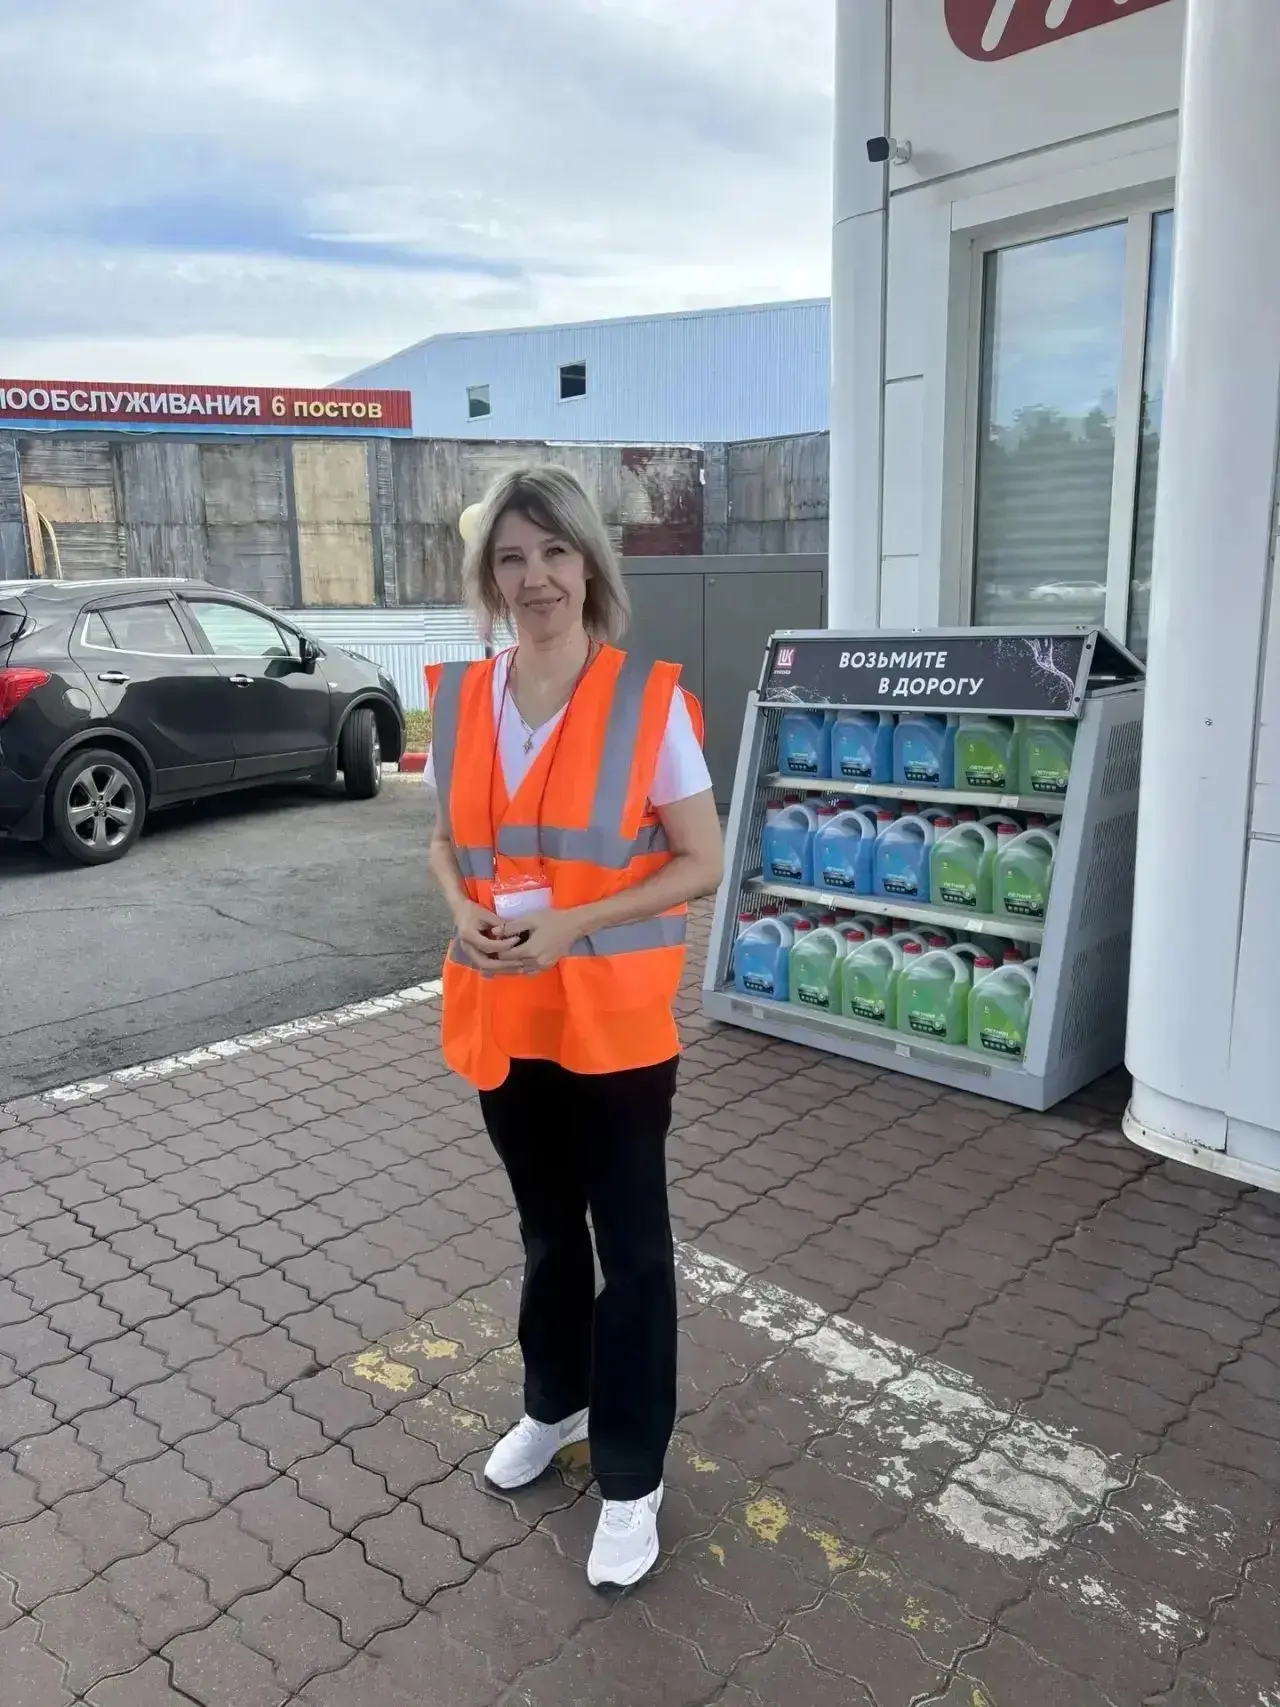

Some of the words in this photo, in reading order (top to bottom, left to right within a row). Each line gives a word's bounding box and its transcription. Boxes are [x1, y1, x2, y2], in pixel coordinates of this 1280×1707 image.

[271, 395, 287, 417] 6
[838, 651, 948, 669] ВОЗЬМИТЕ
[878, 677, 891, 694] В
[892, 677, 984, 697] ДОРОГУ
